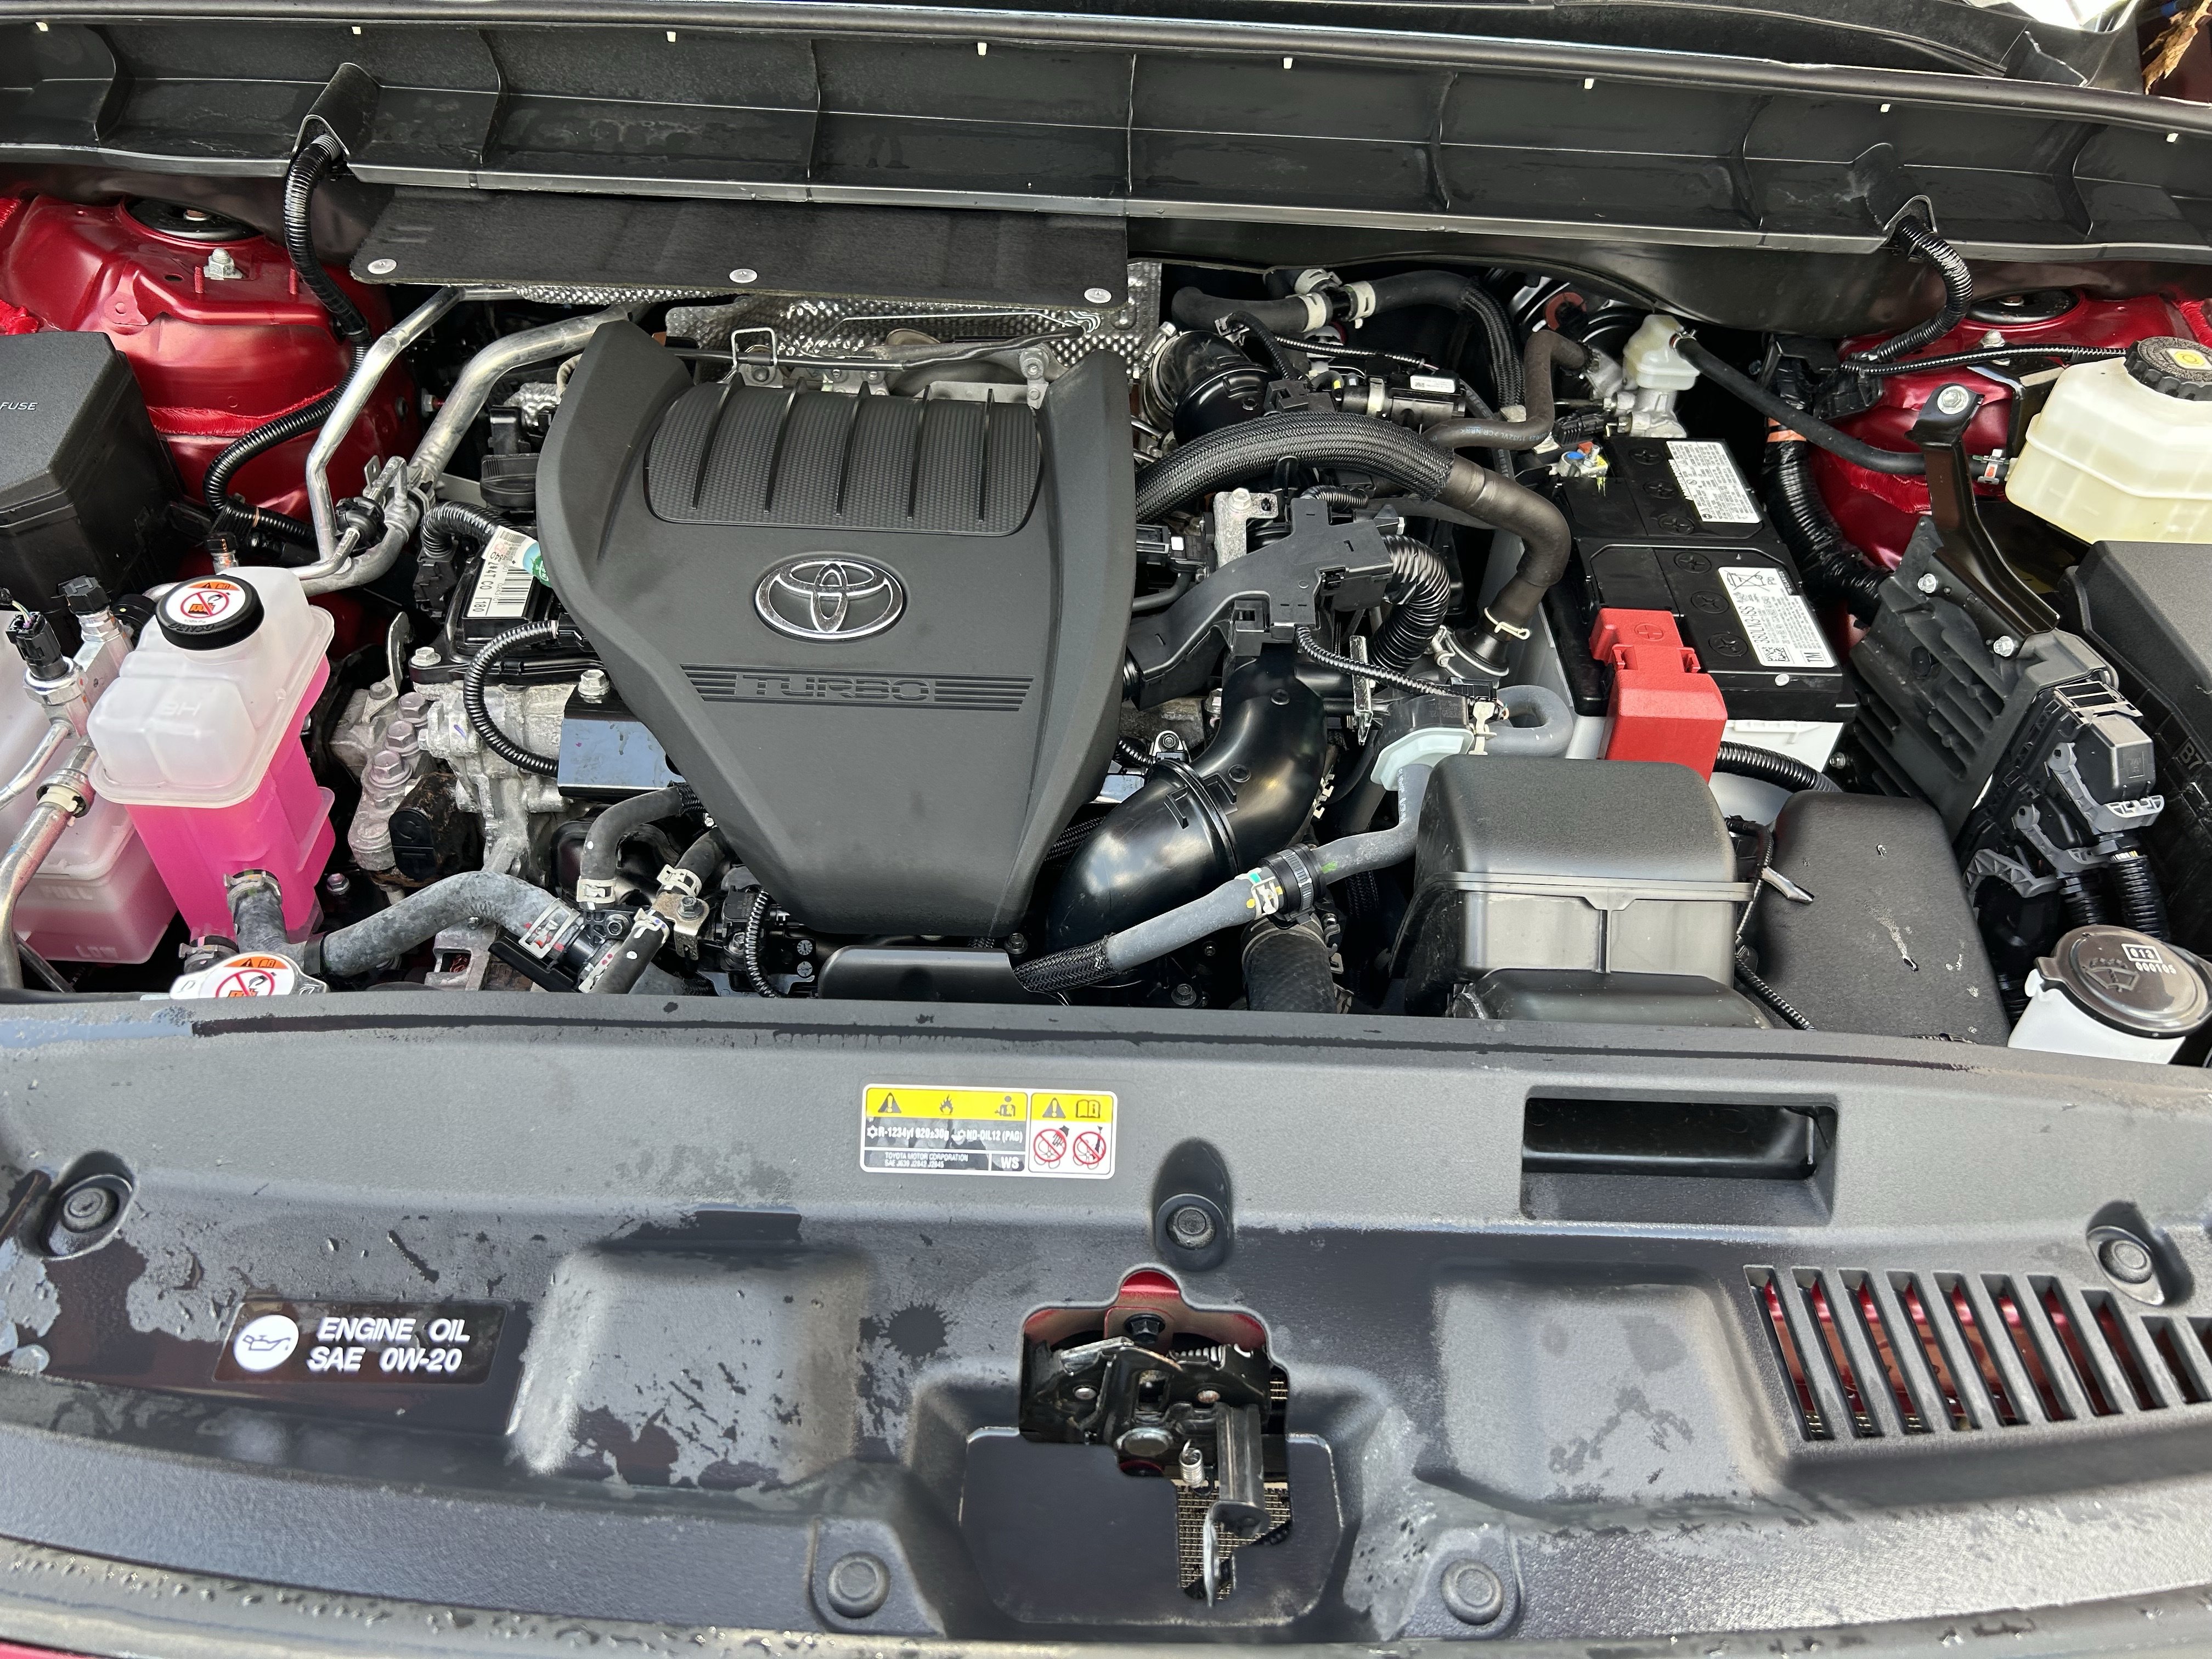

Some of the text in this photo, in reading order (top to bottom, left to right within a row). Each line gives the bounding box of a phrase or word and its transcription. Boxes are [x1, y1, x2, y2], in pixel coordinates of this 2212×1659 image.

[0, 402, 39, 410] FUSE
[743, 674, 932, 701] TURBO
[929, 1153, 968, 1161] CORPORATION
[1001, 1156, 1019, 1169] WS
[317, 1317, 471, 1343] ENGINE OIL
[306, 1346, 463, 1373] SAE 0W-20
